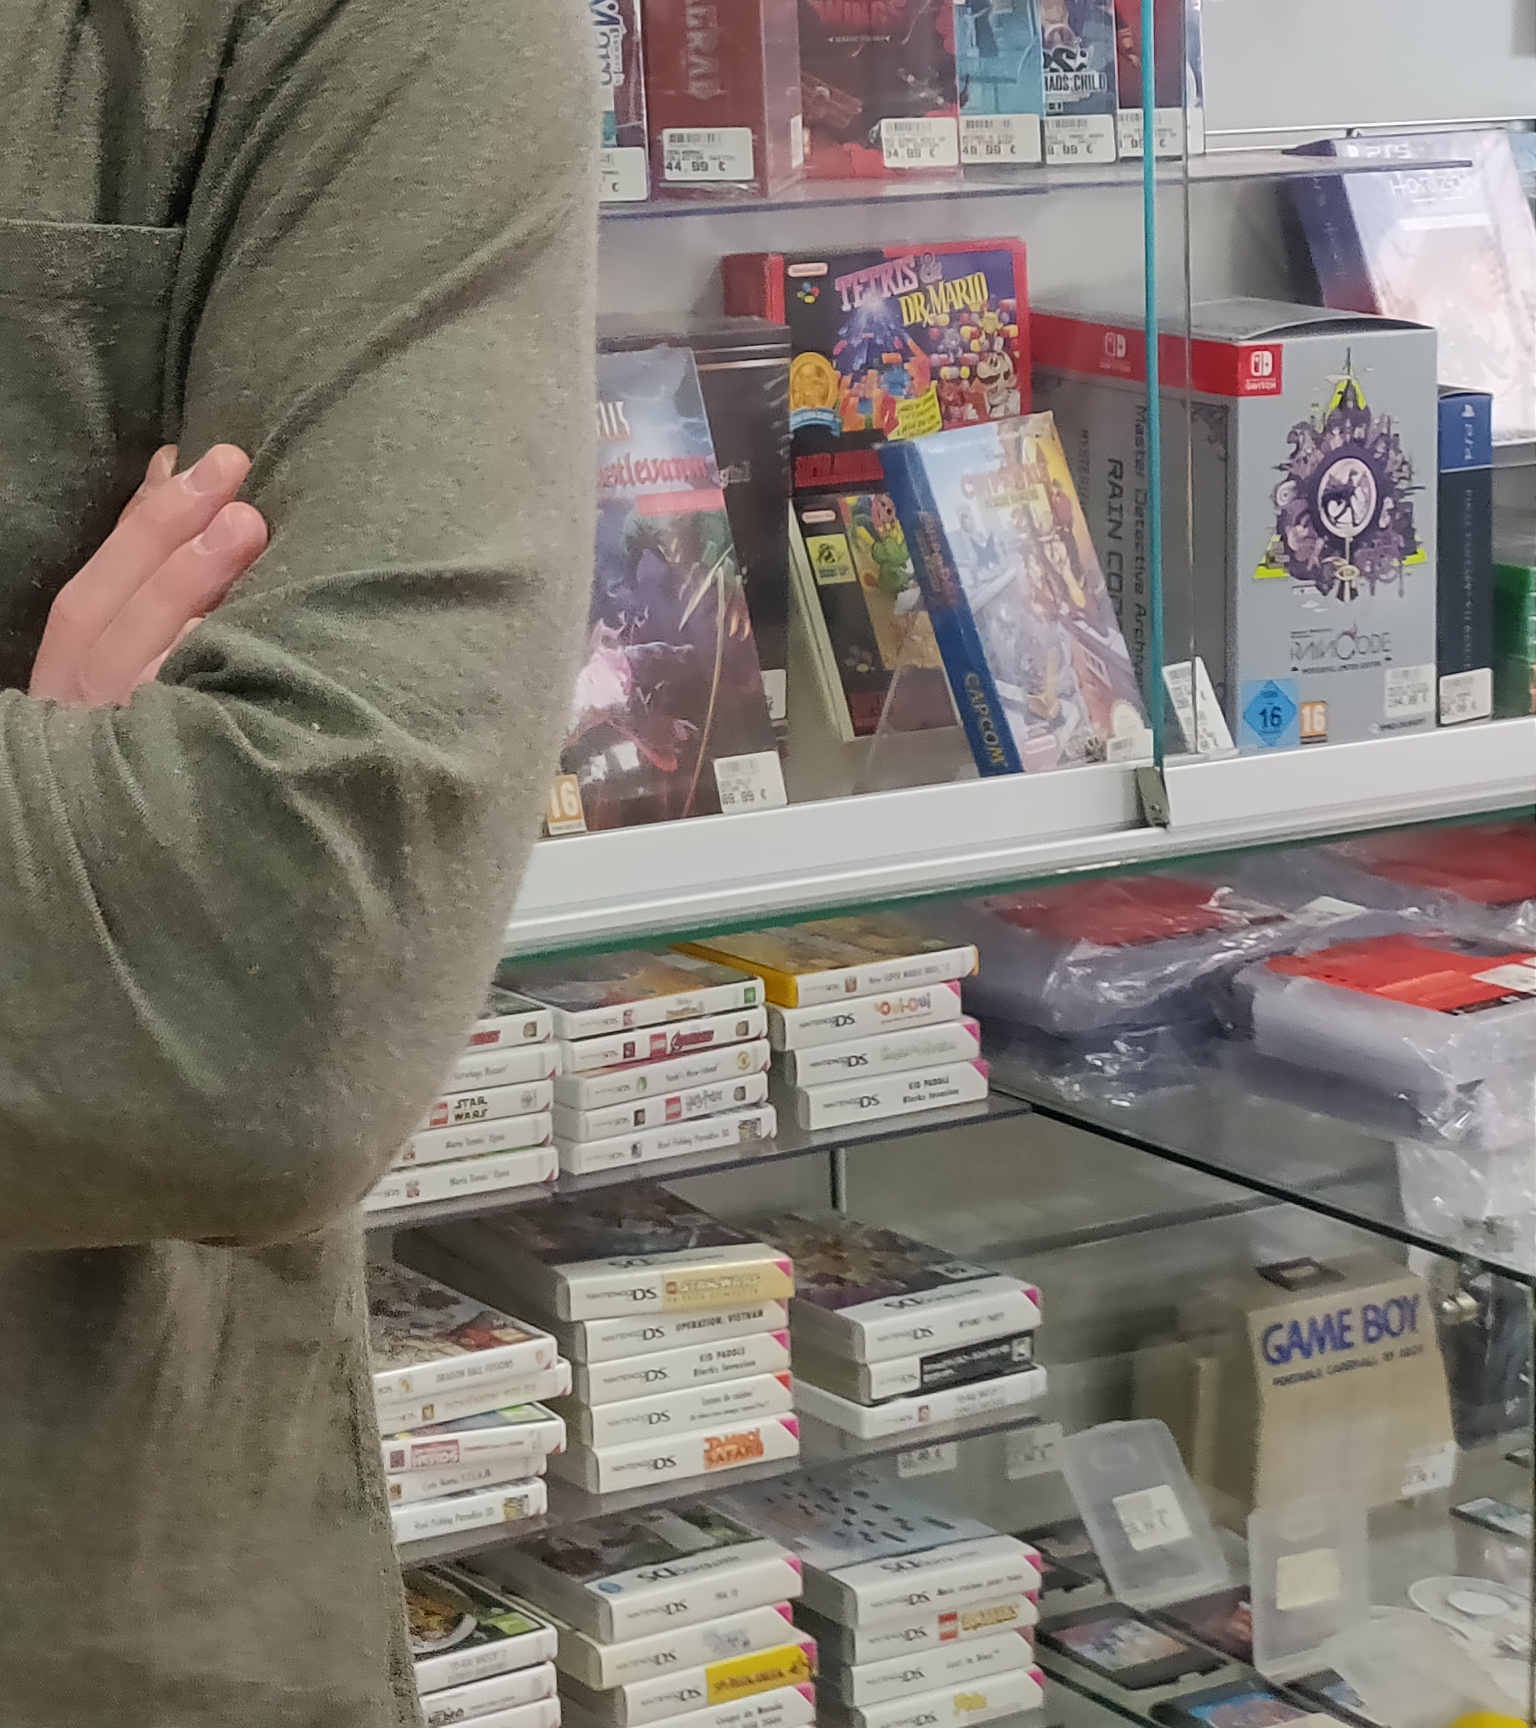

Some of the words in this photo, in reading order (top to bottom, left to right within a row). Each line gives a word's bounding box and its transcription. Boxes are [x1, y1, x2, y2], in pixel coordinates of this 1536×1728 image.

[836, 257, 918, 311] TETRIS
[963, 673, 1004, 767] CAPCOM
[1259, 706, 1282, 727] 16
[1302, 703, 1326, 732] 16
[1263, 1308, 1353, 1366] GAME
[1362, 1294, 1422, 1343] BOY
